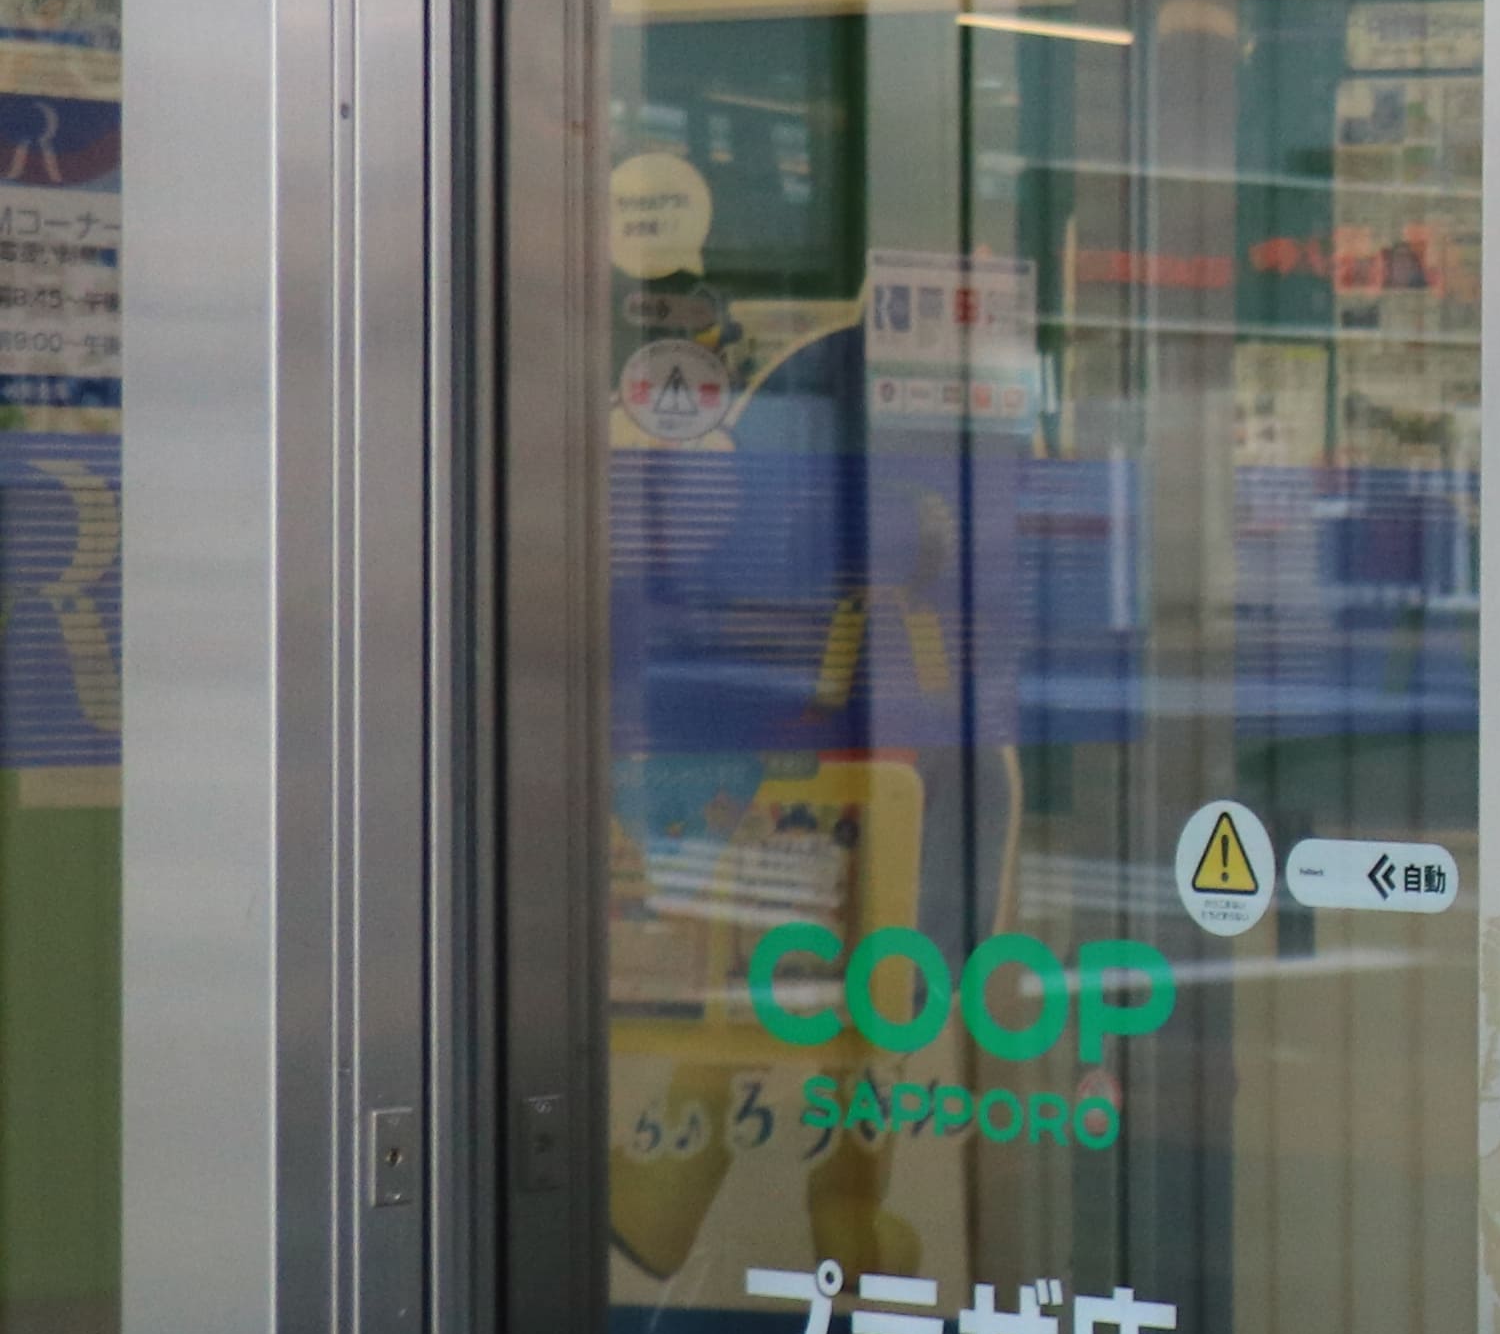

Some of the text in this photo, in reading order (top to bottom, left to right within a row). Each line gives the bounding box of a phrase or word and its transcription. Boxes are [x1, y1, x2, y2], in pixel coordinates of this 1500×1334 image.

[1402, 864, 1447, 895] 自動
[748, 921, 1176, 1064] COOP
[801, 1075, 1121, 1151] SAPPORO
